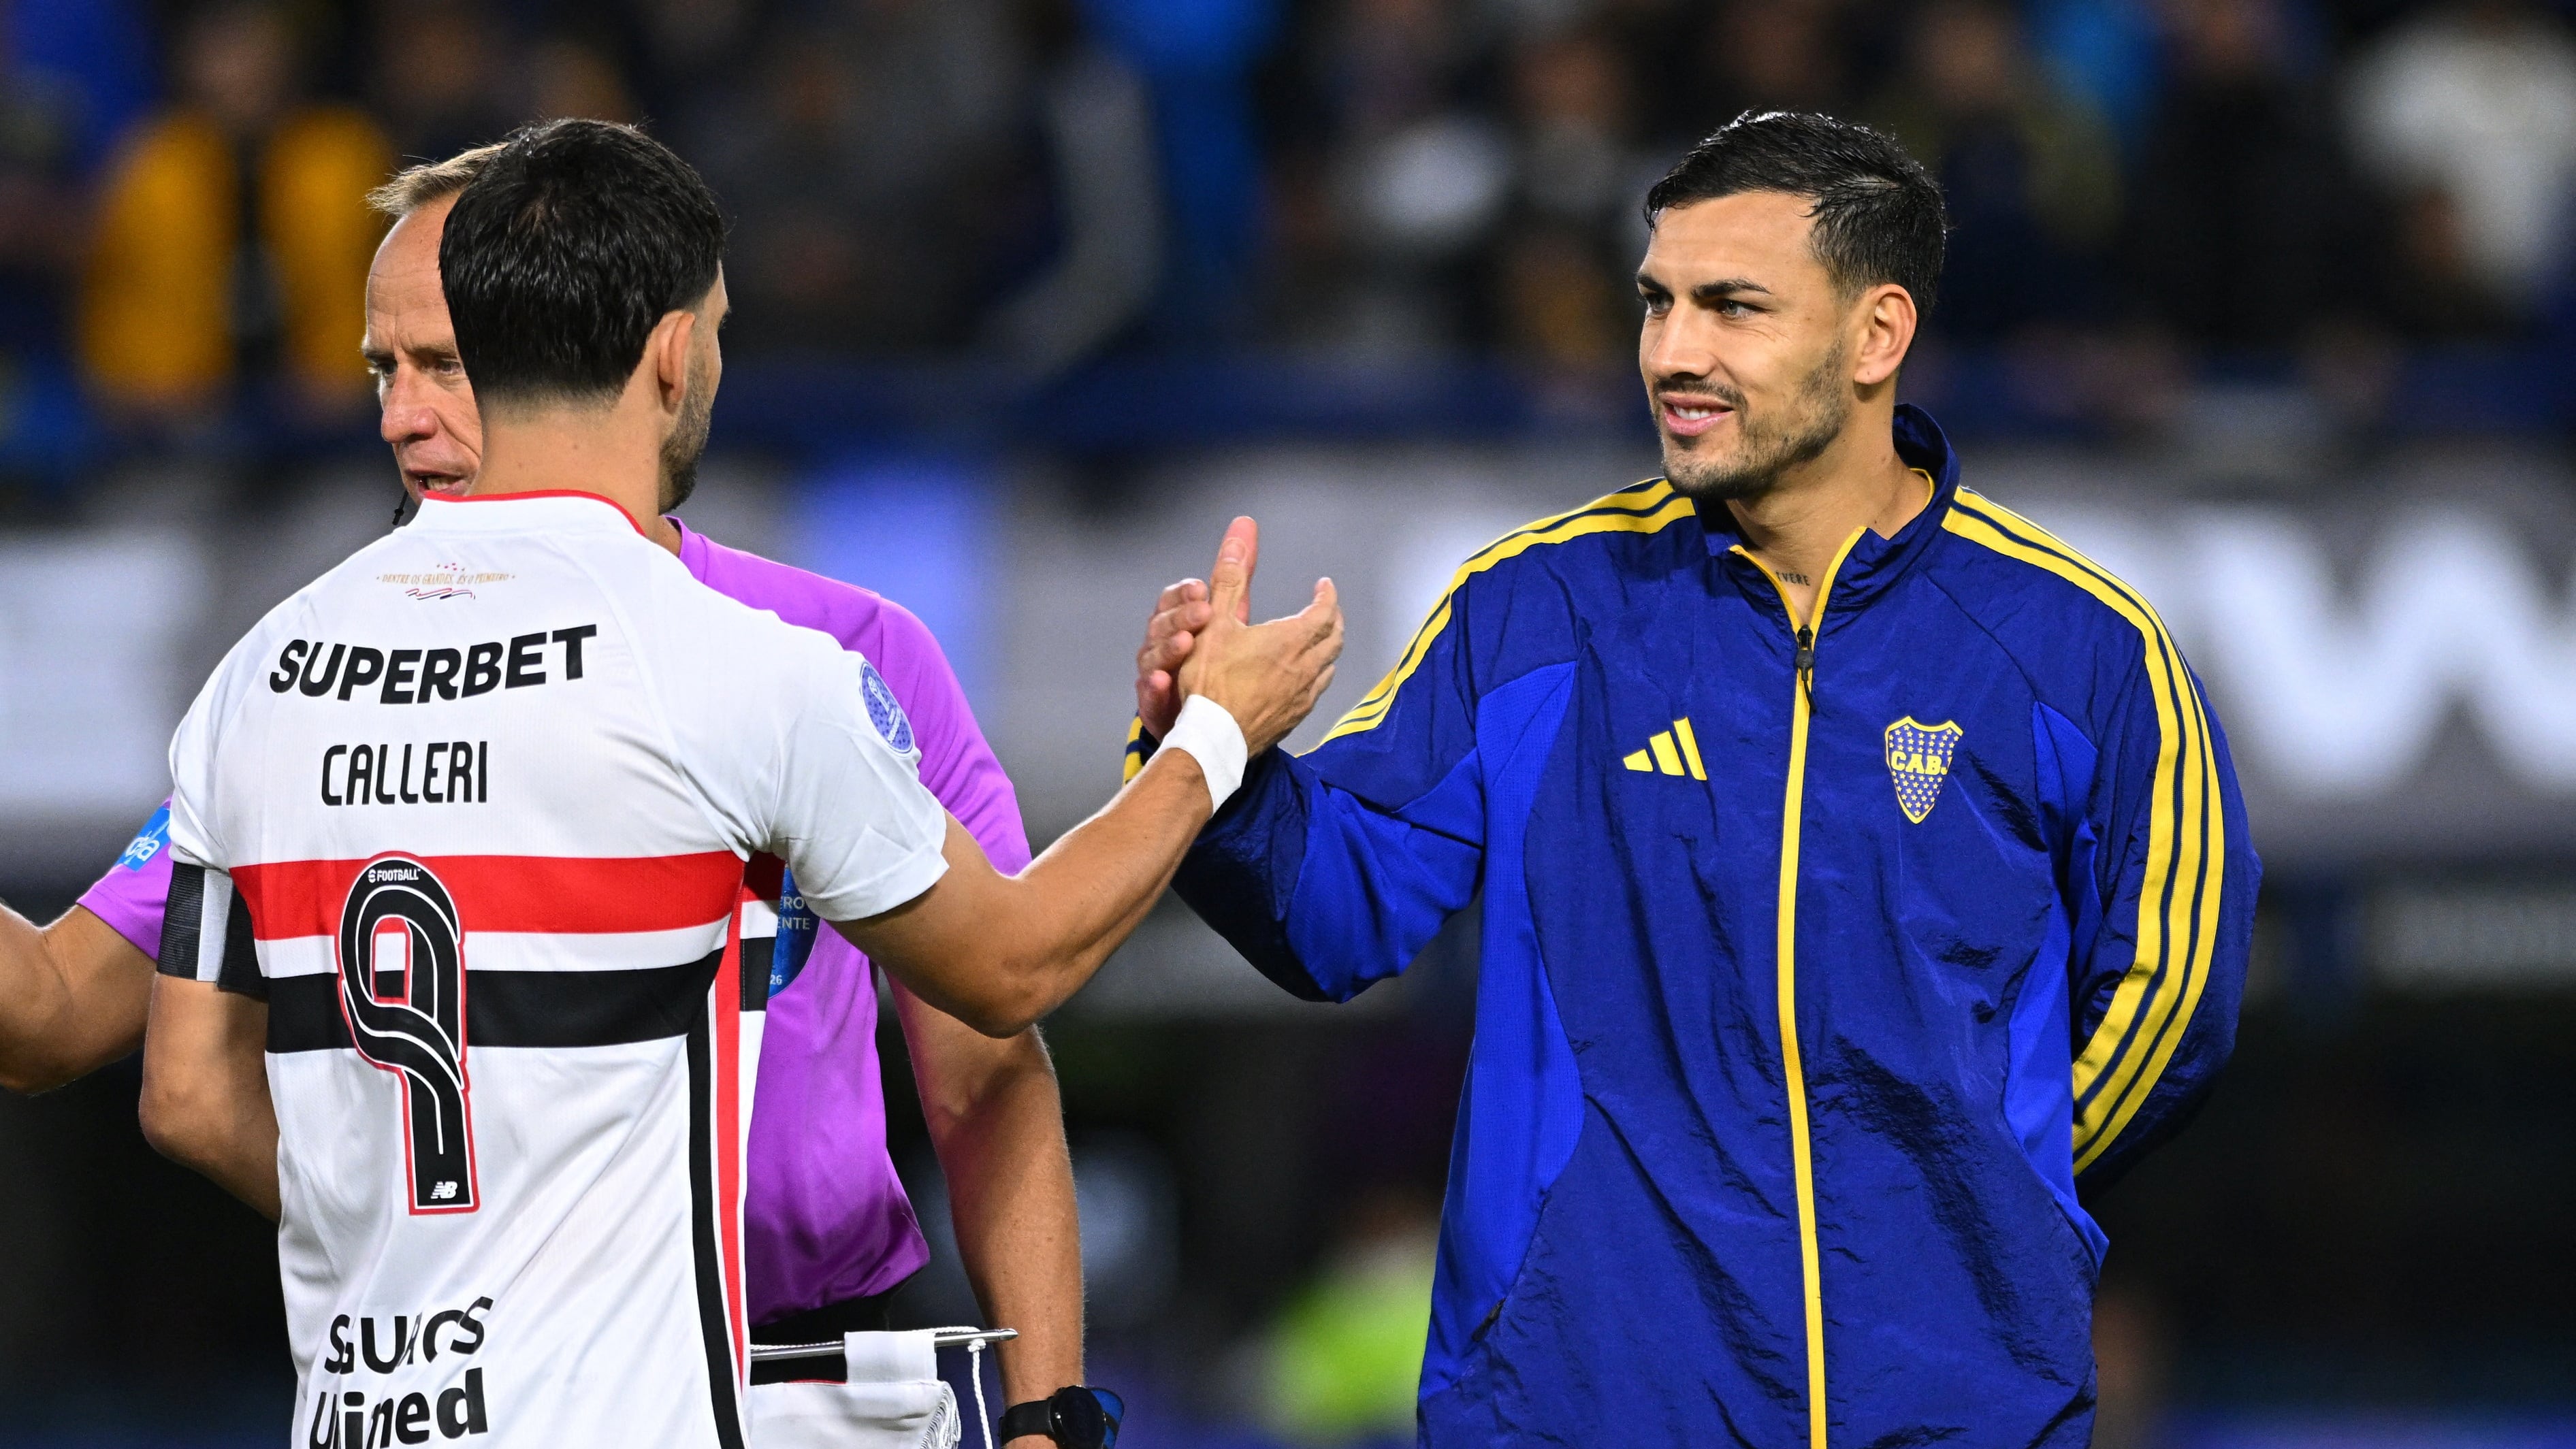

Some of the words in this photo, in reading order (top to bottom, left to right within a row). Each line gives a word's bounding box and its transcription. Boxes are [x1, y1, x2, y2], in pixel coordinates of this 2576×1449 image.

[270, 623, 597, 705] SUPERBET
[321, 740, 487, 806] CALLERI
[335, 851, 481, 1216] 9
